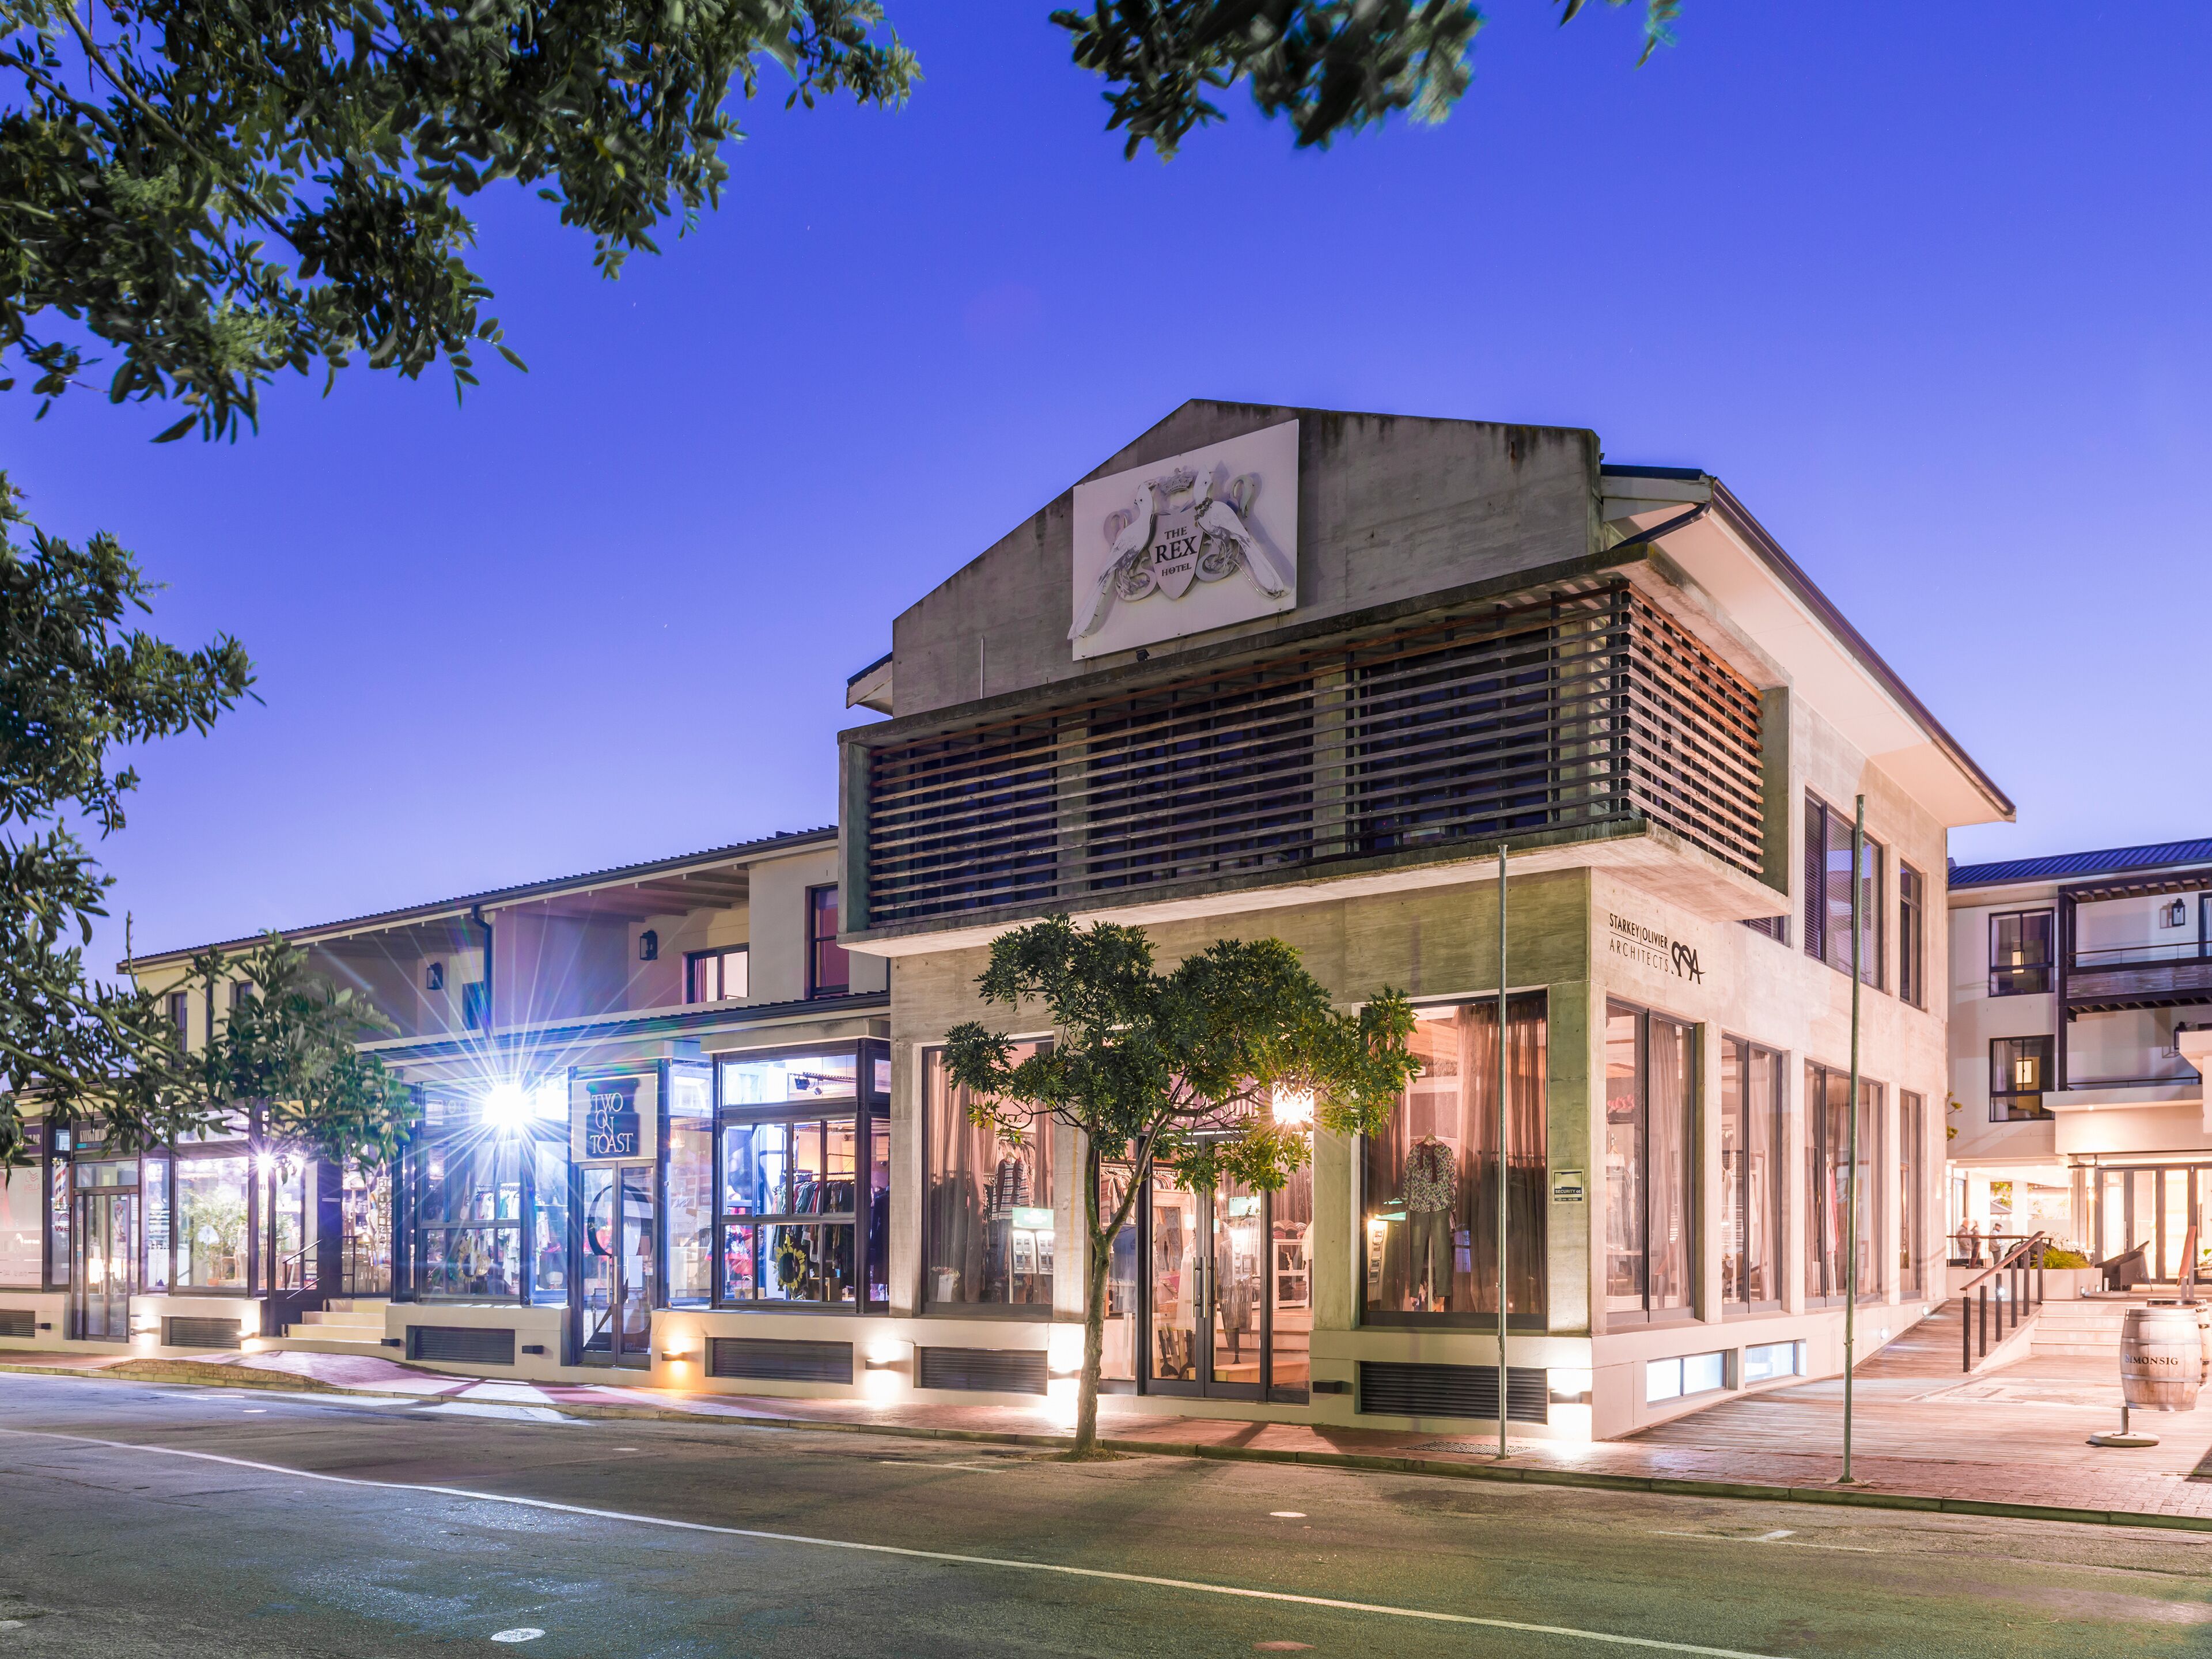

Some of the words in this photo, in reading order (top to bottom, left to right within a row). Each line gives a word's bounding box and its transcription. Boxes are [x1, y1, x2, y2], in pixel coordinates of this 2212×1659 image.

[1164, 526, 1187, 540] THE
[1155, 536, 1198, 564] REX
[1162, 563, 1192, 576] HOTEL
[1609, 938, 1668, 972] ARCHITECTS
[591, 1092, 623, 1113] TWO
[596, 1109, 615, 1135] ON
[590, 1132, 634, 1154] TOAST
[2125, 1354, 2178, 1365] SIMONSIG
